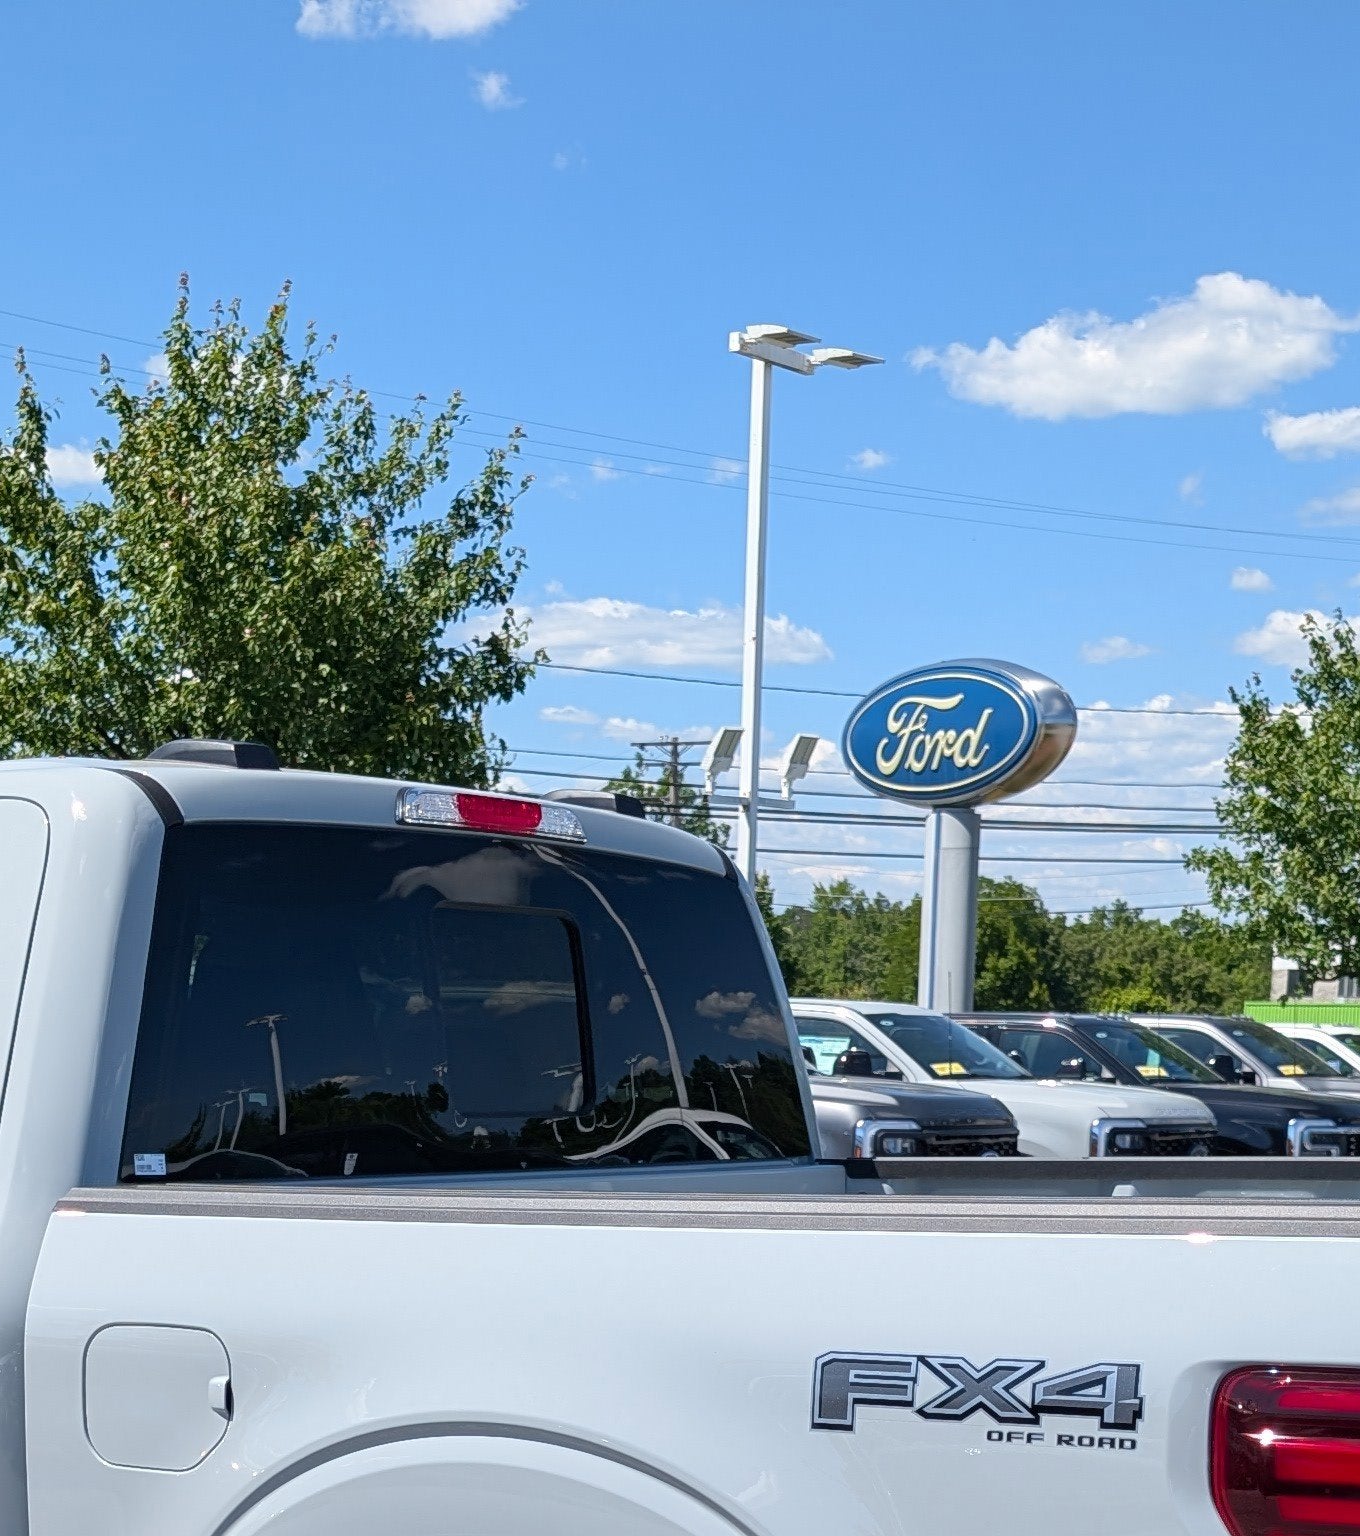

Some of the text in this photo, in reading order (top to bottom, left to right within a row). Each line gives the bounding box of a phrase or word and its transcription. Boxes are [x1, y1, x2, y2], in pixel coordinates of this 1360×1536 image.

[876, 692, 995, 776] Ford
[809, 1350, 1144, 1432] FX4
[986, 1430, 1138, 1451] OFF ROAD
